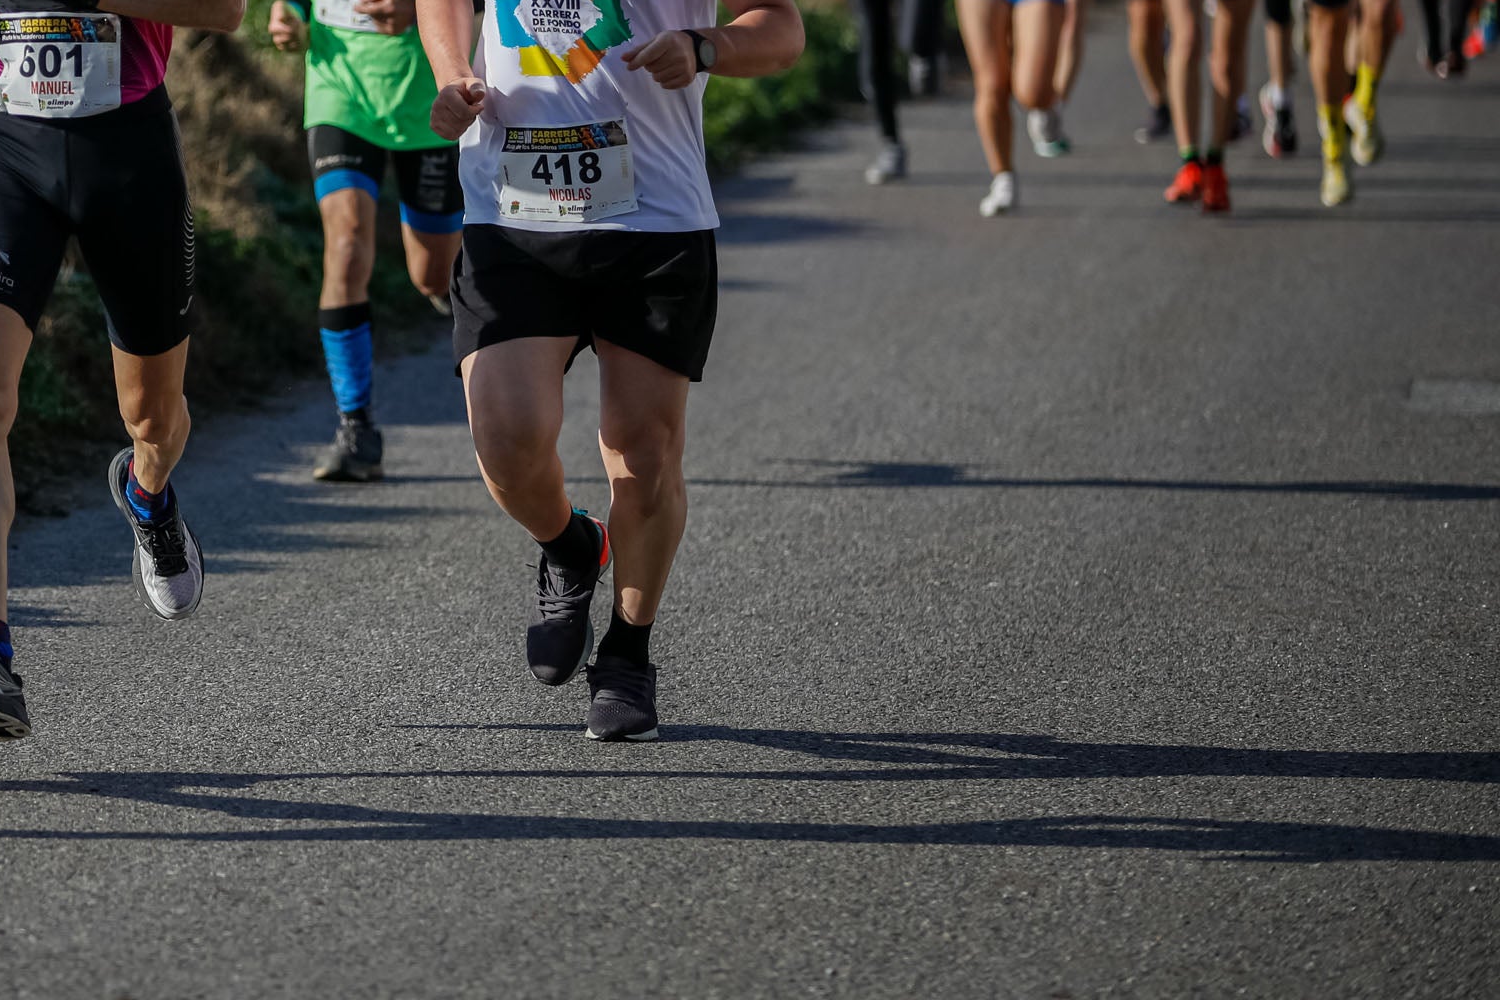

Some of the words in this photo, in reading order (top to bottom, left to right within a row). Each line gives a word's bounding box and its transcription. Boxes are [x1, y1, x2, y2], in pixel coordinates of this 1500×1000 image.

[531, 8, 581, 20] CARRERA
[20, 18, 68, 27] CARRERA
[533, 18, 545, 26] DE
[547, 19, 581, 29] FONDO
[20, 44, 83, 78] 601
[31, 80, 75, 95] MANUEL
[508, 130, 518, 140] 26
[532, 129, 578, 138] CARRERA
[532, 136, 580, 144] POPULAR
[531, 152, 602, 186] 418
[548, 187, 592, 201] NICOLAS
